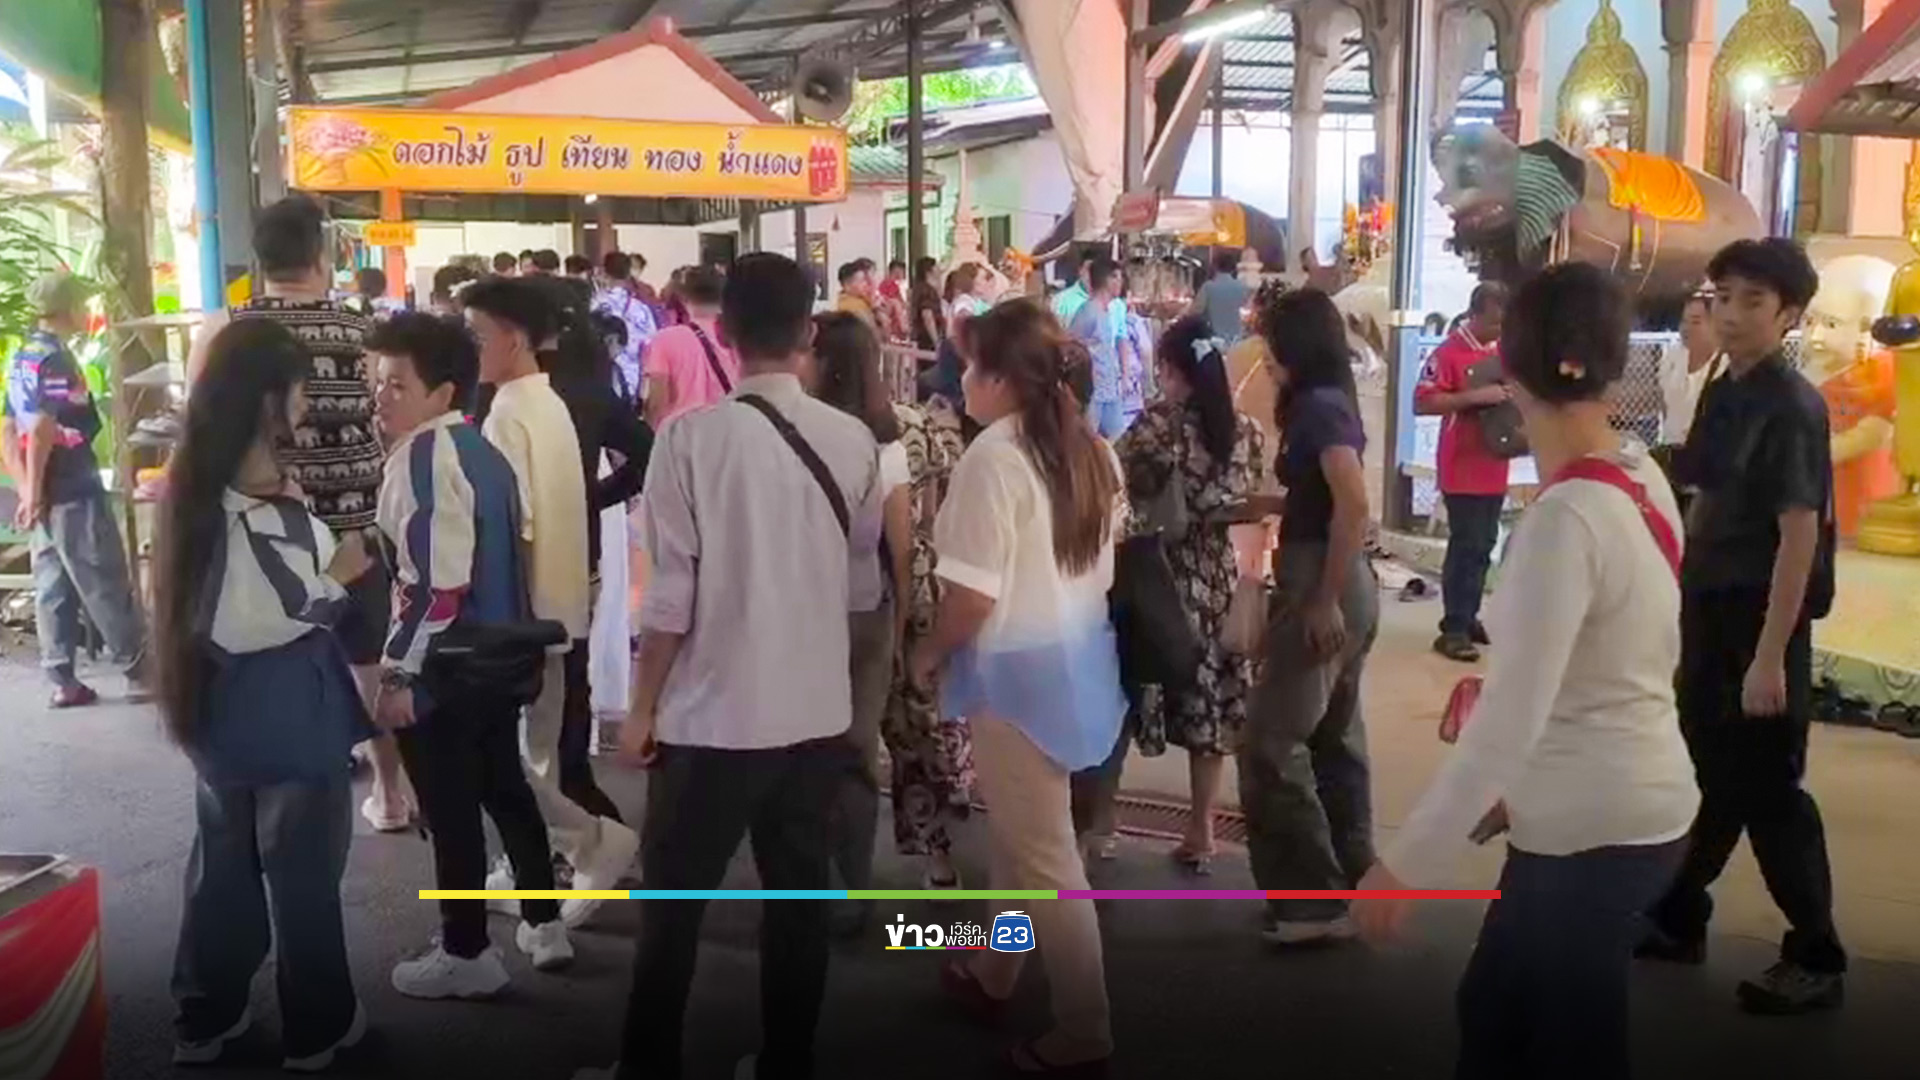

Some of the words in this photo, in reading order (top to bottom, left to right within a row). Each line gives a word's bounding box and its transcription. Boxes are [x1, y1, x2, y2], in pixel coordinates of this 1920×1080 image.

[393, 126, 489, 165] ดอกไม้
[505, 136, 543, 186] ธูป
[562, 134, 629, 170] เทียน
[645, 149, 702, 171] ทอง
[718, 131, 802, 176] น้ำแดง
